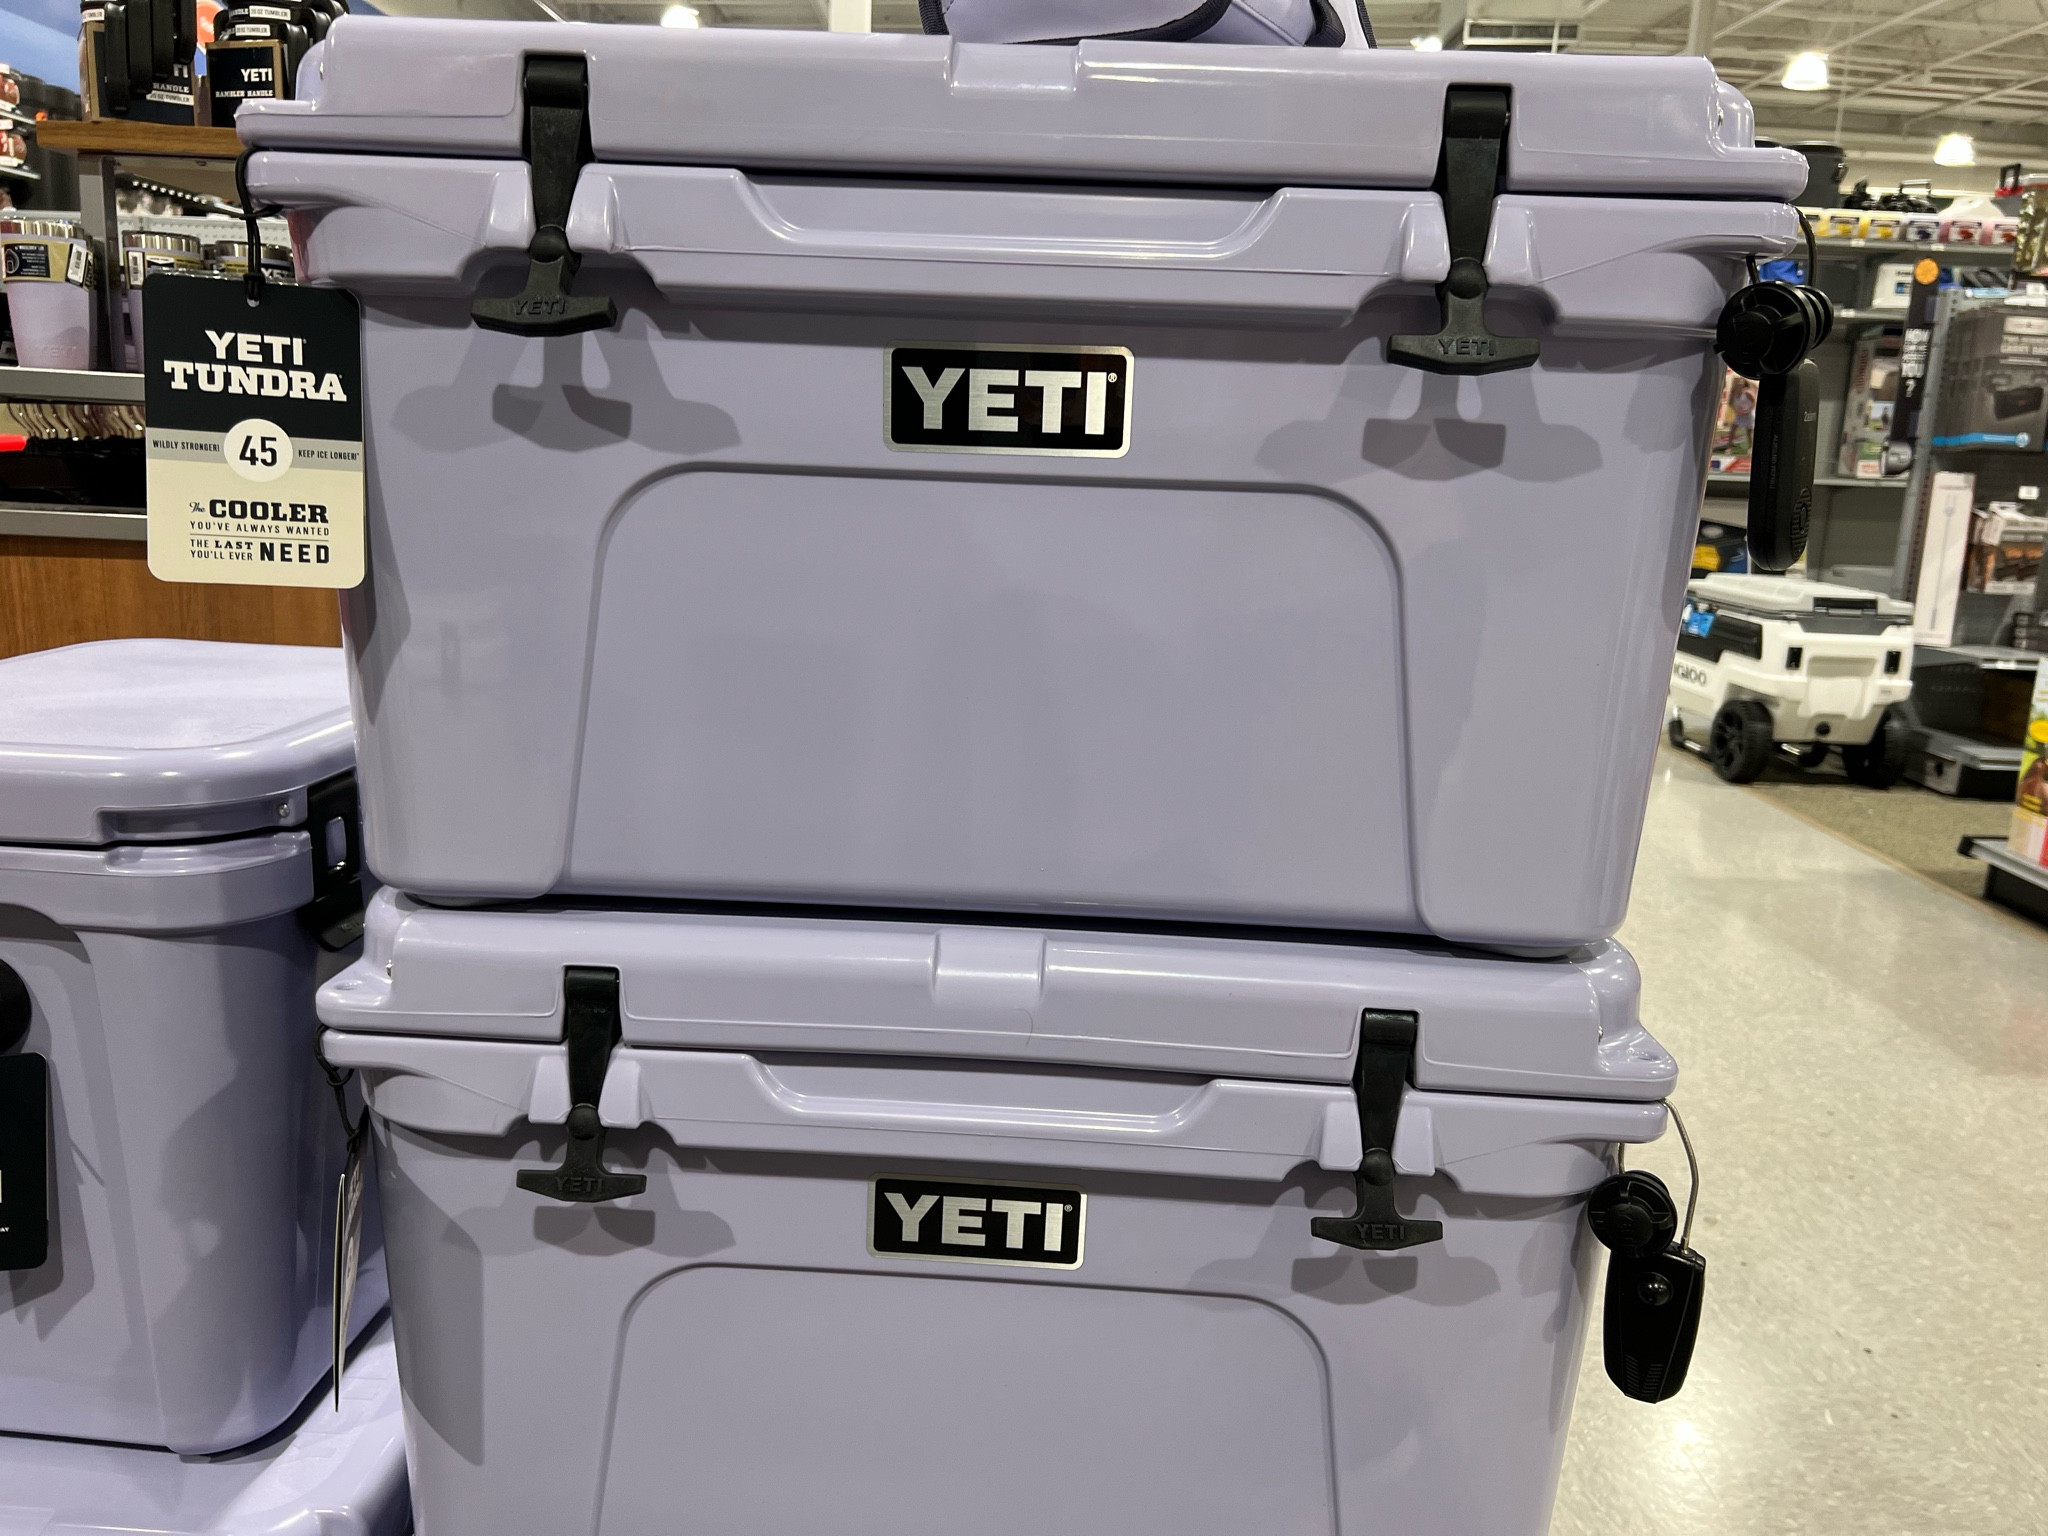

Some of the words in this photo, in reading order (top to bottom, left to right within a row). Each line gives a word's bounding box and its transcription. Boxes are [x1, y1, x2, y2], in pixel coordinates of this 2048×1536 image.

[264, 9, 288, 18] TUMBLER
[241, 68, 273, 82] YETI
[152, 82, 189, 93] HANDLE
[215, 90, 245, 98] RAMBLER
[247, 89, 274, 97] HANDLE
[514, 299, 568, 316] YETI
[204, 330, 304, 366] YETI
[1438, 338, 1497, 357] YETI
[163, 359, 348, 402] TUNDRA
[901, 365, 1108, 436] YETI
[153, 439, 179, 449] WILDLY
[239, 434, 277, 467] 45
[298, 449, 315, 458] KEEP
[317, 450, 328, 459] ICE
[189, 501, 206, 513] The
[209, 498, 329, 524] COOLER
[190, 520, 231, 532] YOU'VE
[236, 523, 280, 534] ALWAYS
[286, 525, 329, 536] WANTED
[190, 538, 209, 548] THE
[214, 539, 253, 550] LAST
[259, 541, 330, 564] NEED
[190, 549, 225, 560] YOU'LL
[229, 551, 253, 561] EVER
[555, 1176, 607, 1193] YETI
[883, 1192, 1064, 1252] YETI
[1355, 1223, 1406, 1240] YETI
